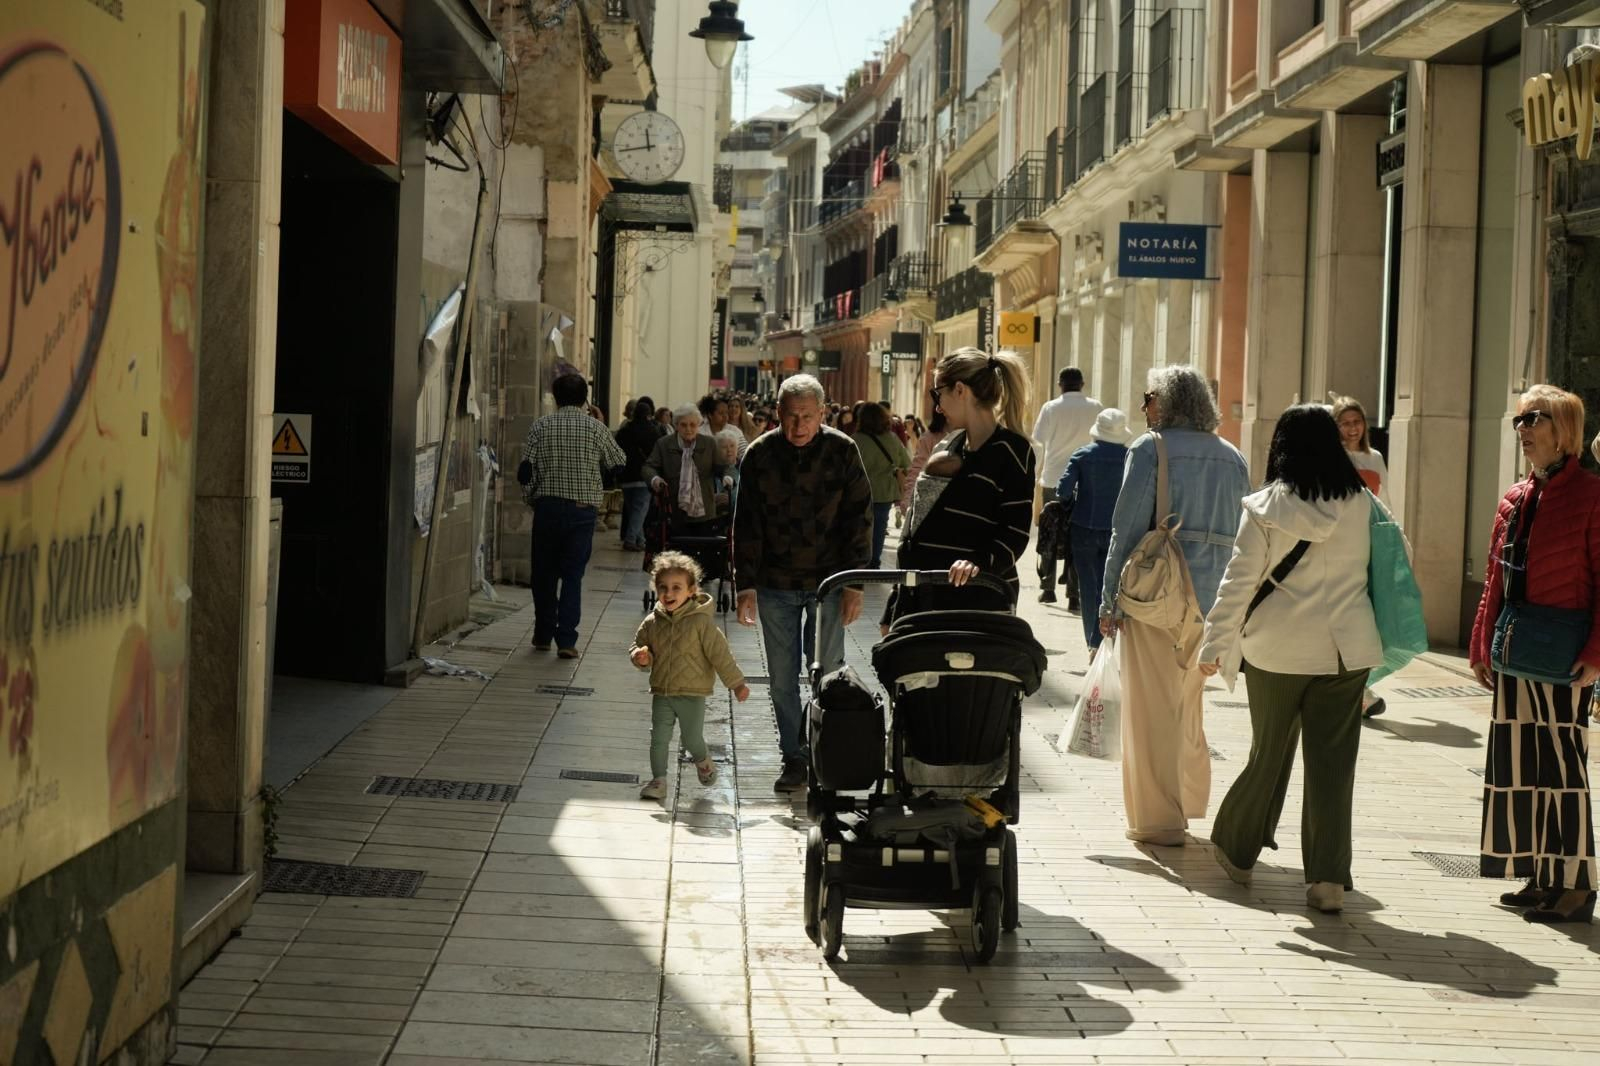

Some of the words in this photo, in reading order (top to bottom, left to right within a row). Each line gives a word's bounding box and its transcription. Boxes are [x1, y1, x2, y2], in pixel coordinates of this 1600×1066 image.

[1522, 58, 1600, 161] may
[1127, 236, 1198, 249] NOTARÍA
[1169, 256, 1196, 264] NUEVO
[733, 335, 755, 346] BBV
[711, 345, 719, 366] LOLA
[42, 481, 145, 633] sentidos
